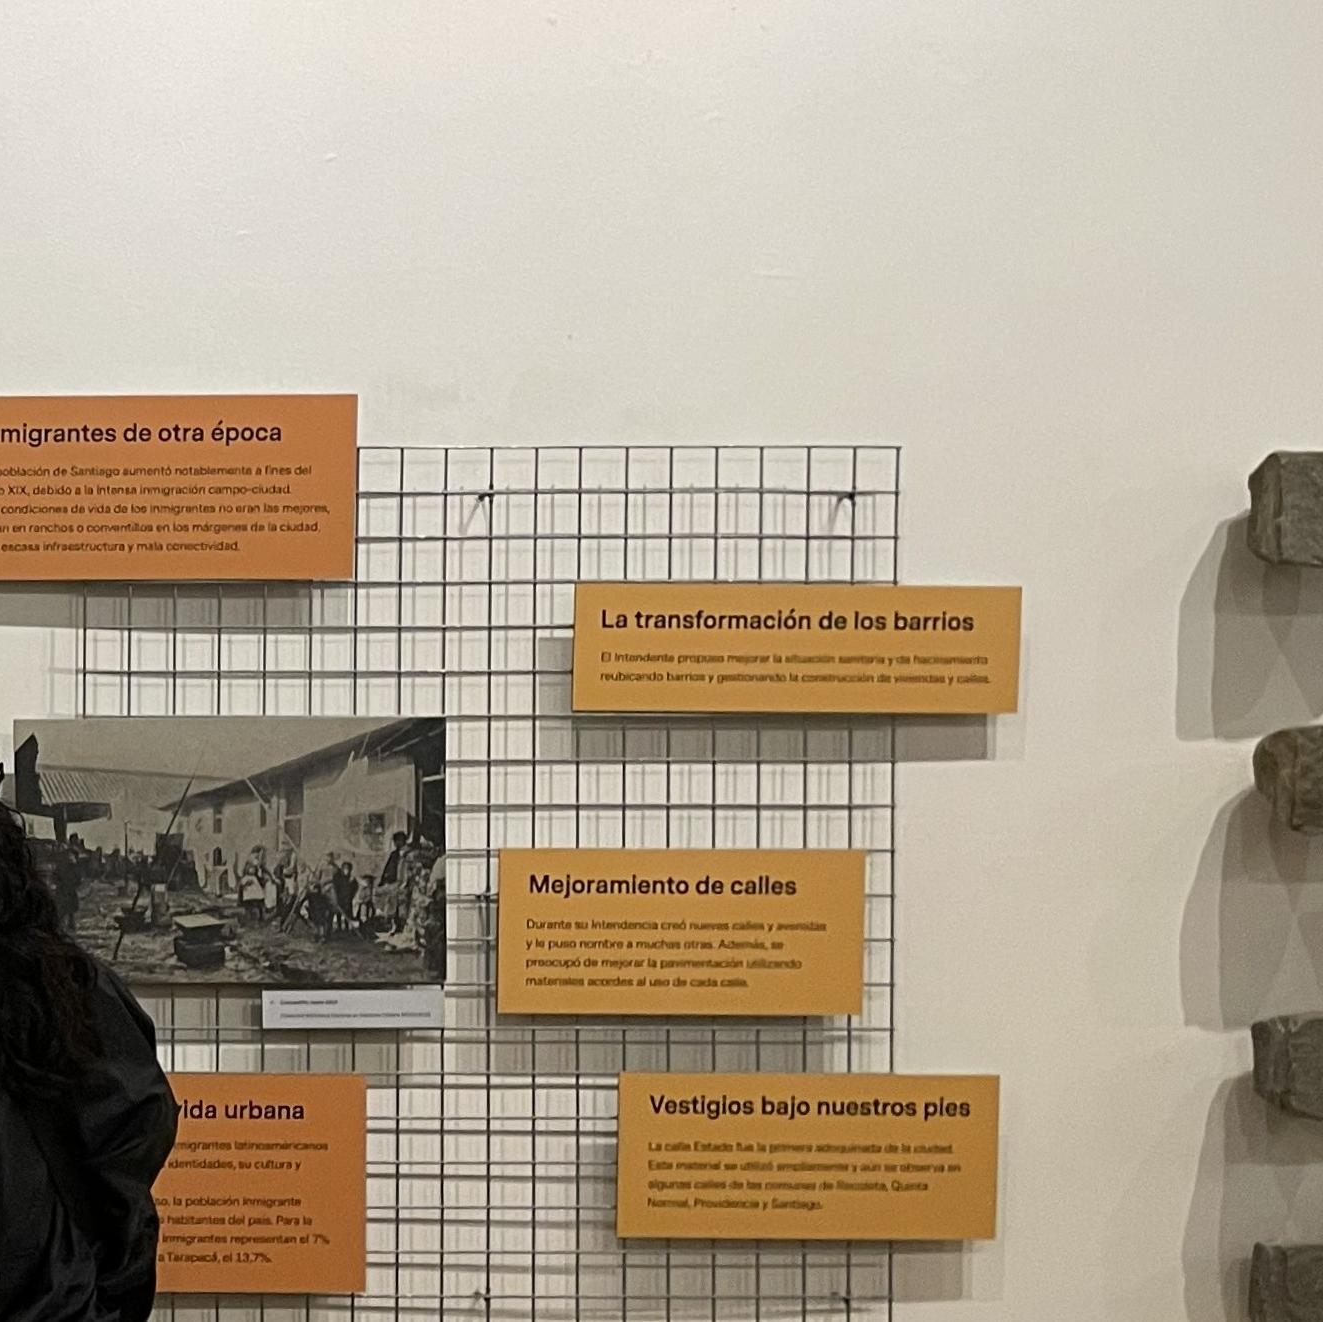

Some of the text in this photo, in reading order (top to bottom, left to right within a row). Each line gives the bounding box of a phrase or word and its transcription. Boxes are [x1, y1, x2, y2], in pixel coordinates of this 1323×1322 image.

[123, 422, 152, 443] de
[158, 423, 205, 443] otra
[210, 420, 282, 447] época
[7, 484, 31, 497] XIX,
[32, 484, 73, 496] debido
[74, 486, 82, 496] a
[83, 484, 94, 496] la
[96, 484, 138, 496] intensa
[139, 485, 206, 497] inmigración
[601, 607, 975, 632] La transformación de los barrios
[529, 873, 798, 898] Mejoramiento de calles
[224, 1099, 305, 1121] urbana
[649, 1094, 971, 1121] Vestigios bajo nuestros pies
[238, 1160, 253, 1170] su
[253, 1159, 293, 1171] cultura
[294, 1161, 302, 1172] y
